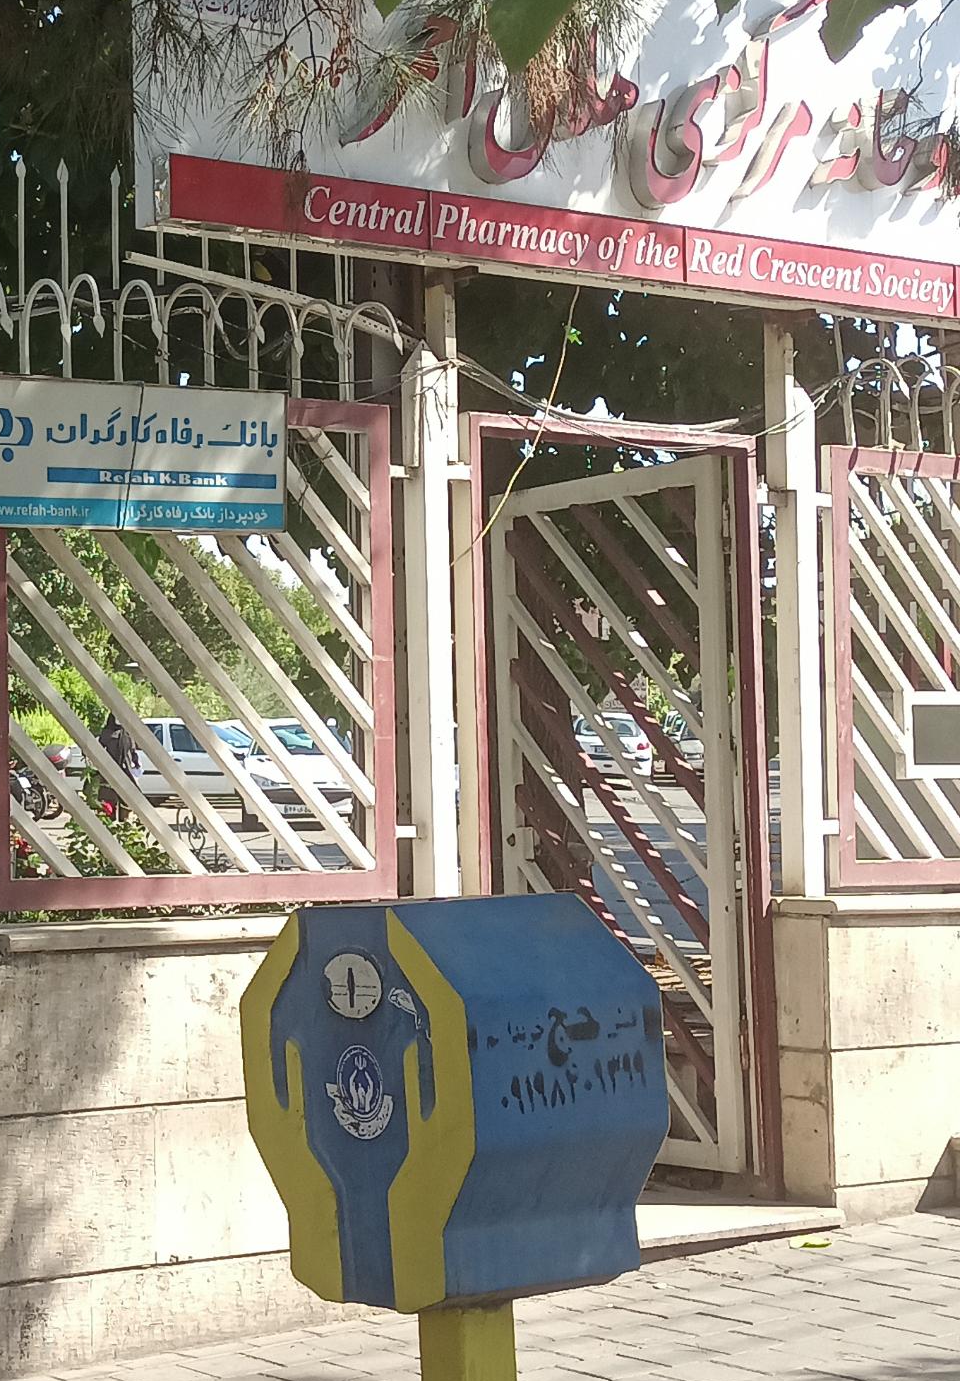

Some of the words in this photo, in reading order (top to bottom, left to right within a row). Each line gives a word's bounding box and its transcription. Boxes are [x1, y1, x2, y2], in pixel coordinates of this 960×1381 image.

[304, 186, 426, 236] Central
[433, 203, 590, 266] Pharmacy
[597, 227, 633, 271] of
[635, 231, 679, 269] the
[688, 237, 744, 277] Red
[749, 246, 862, 293] Crescent
[865, 262, 955, 312] Society
[46, 407, 158, 445] کارگران
[155, 417, 203, 449] رفاه
[207, 420, 278, 457] بانک
[99, 469, 155, 485] Refah
[166, 505, 188, 522] رفاه
[190, 506, 215, 522] بانک
[218, 508, 268, 524] خودپرداز
[548, 1006, 601, 1066] حج
